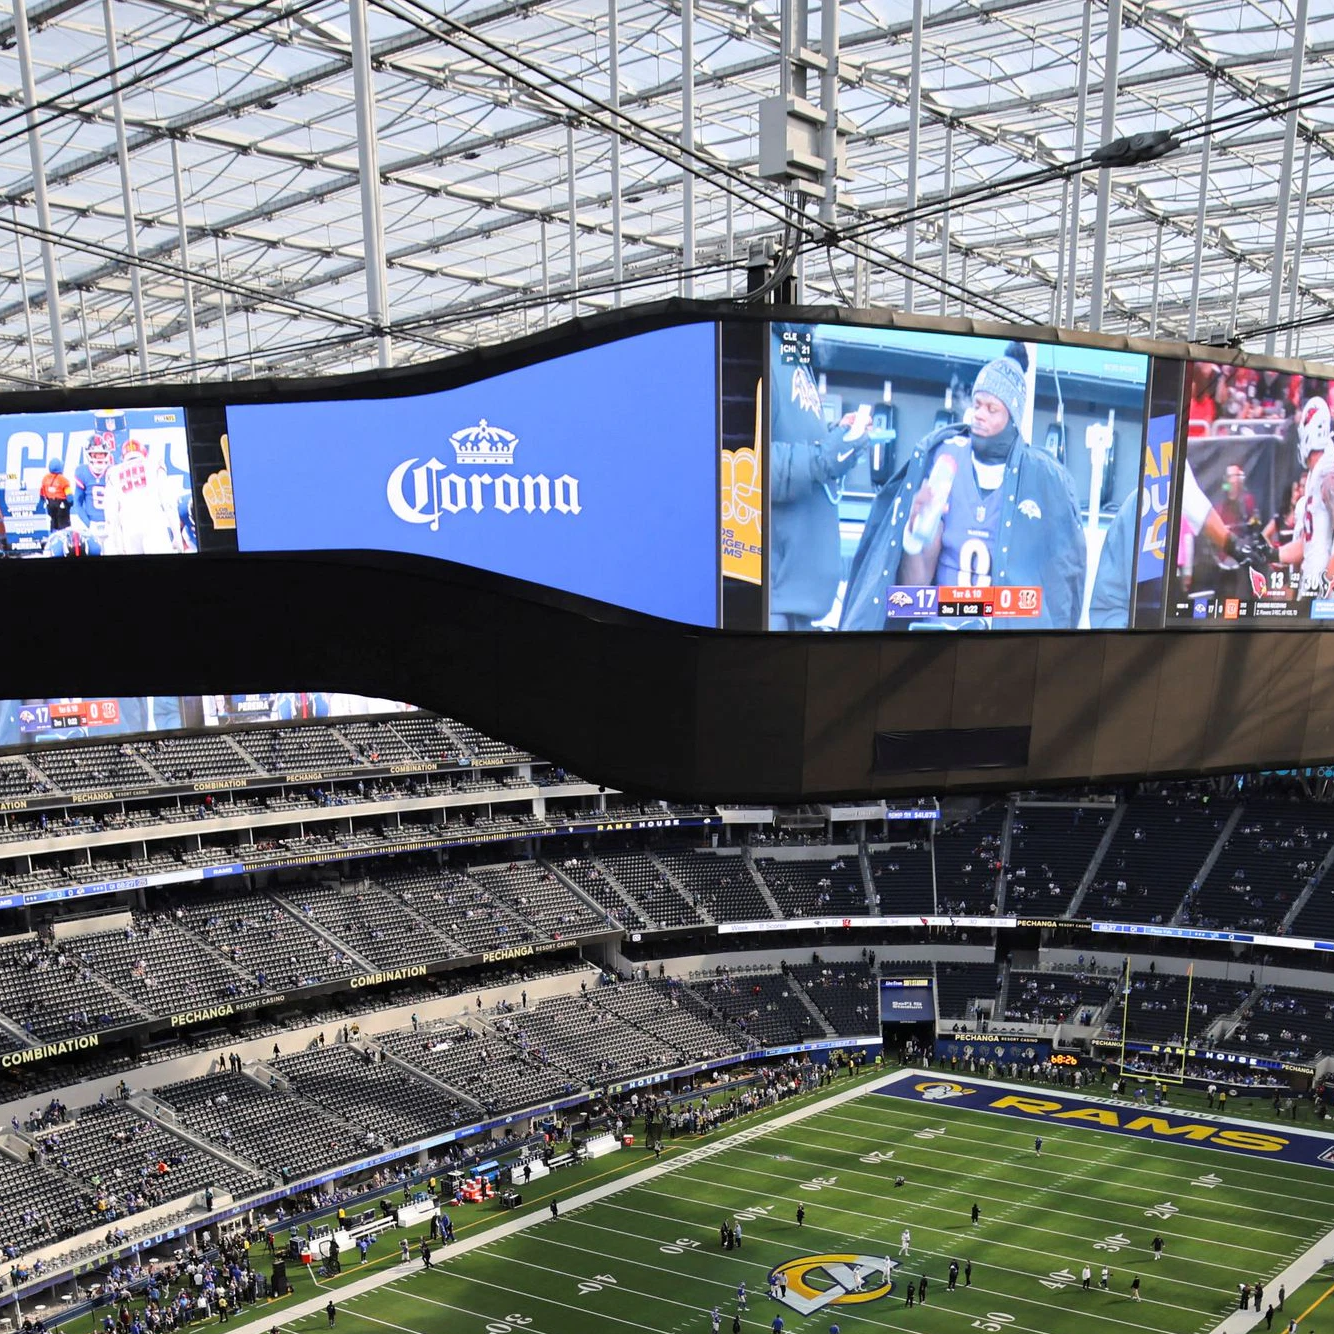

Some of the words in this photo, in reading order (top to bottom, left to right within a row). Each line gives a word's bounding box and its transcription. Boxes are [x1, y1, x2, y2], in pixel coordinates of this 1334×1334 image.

[783, 332, 798, 341] CLE
[805, 333, 811, 342] 3
[784, 344, 796, 353] CHI
[801, 346, 810, 354] 21
[386, 455, 582, 532] Corona
[1271, 572, 1285, 589] 13
[917, 589, 937, 608] 17
[972, 590, 982, 598] 10
[1000, 590, 1011, 608] 0
[35, 707, 49, 724] 17
[90, 702, 98, 719] 0
[237, 701, 269, 712] PEREIRA
[389, 763, 438, 774] COMBINATION
[471, 758, 504, 767] PECHANGA
[193, 779, 247, 791] COMBINATION
[286, 772, 323, 782] PECHANGA
[72, 792, 115, 804] PECHANGA
[597, 823, 632, 831] RAMS
[639, 819, 680, 828] HOUSE
[1017, 919, 1058, 928] PECHANGA
[483, 946, 535, 963] PECHANGA
[535, 943, 555, 953] RESORT
[557, 940, 577, 949] CASINO
[349, 965, 427, 988] COMBINATION
[171, 1004, 235, 1028] PECHANGA
[235, 1000, 261, 1011] RESORT
[261, 994, 285, 1006] CASINO
[955, 1034, 1000, 1042] PECHANGA
[1, 1034, 99, 1068] COMBINATION
[1205, 1052, 1258, 1066] HOUSE
[1051, 1054, 1077, 1066] 68:26
[1281, 1064, 1315, 1075] PECHANGA
[629, 1073, 669, 1089] HOUSE
[989, 1095, 1291, 1153] RAMS
[1175, 1110, 1224, 1122] LOVE
[913, 1127, 945, 1139] 10
[657, 1144, 719, 1170] INSPIRE
[719, 1123, 777, 1149] CHANGE
[859, 1150, 895, 1164] 20
[799, 1176, 837, 1191] 30
[1191, 1173, 1223, 1189] 10
[734, 1205, 774, 1222] 40
[1144, 1202, 1180, 1220] 20
[660, 1237, 701, 1255] 50
[1093, 1233, 1131, 1252] 30
[72, 1251, 121, 1276] RAMS
[131, 1226, 187, 1252] HOUSE
[578, 1272, 618, 1295] 40
[1039, 1268, 1077, 1290] 40
[971, 1312, 1016, 1332] 50
